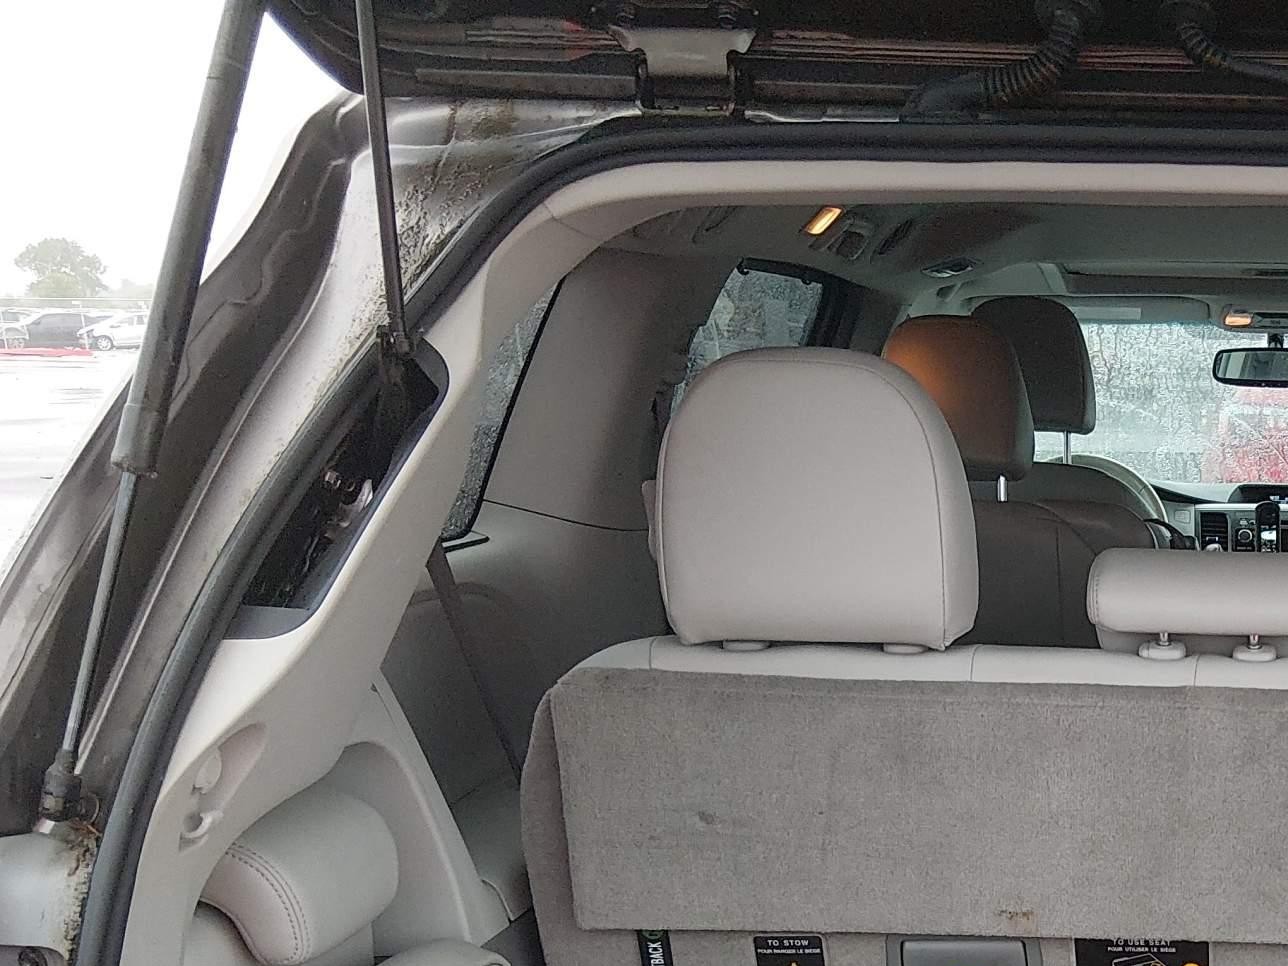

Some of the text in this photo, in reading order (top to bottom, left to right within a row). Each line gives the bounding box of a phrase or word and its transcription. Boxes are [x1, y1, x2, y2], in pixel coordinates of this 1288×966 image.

[768, 939, 780, 947] TO
[1113, 938, 1171, 946] TO USE SEAT
